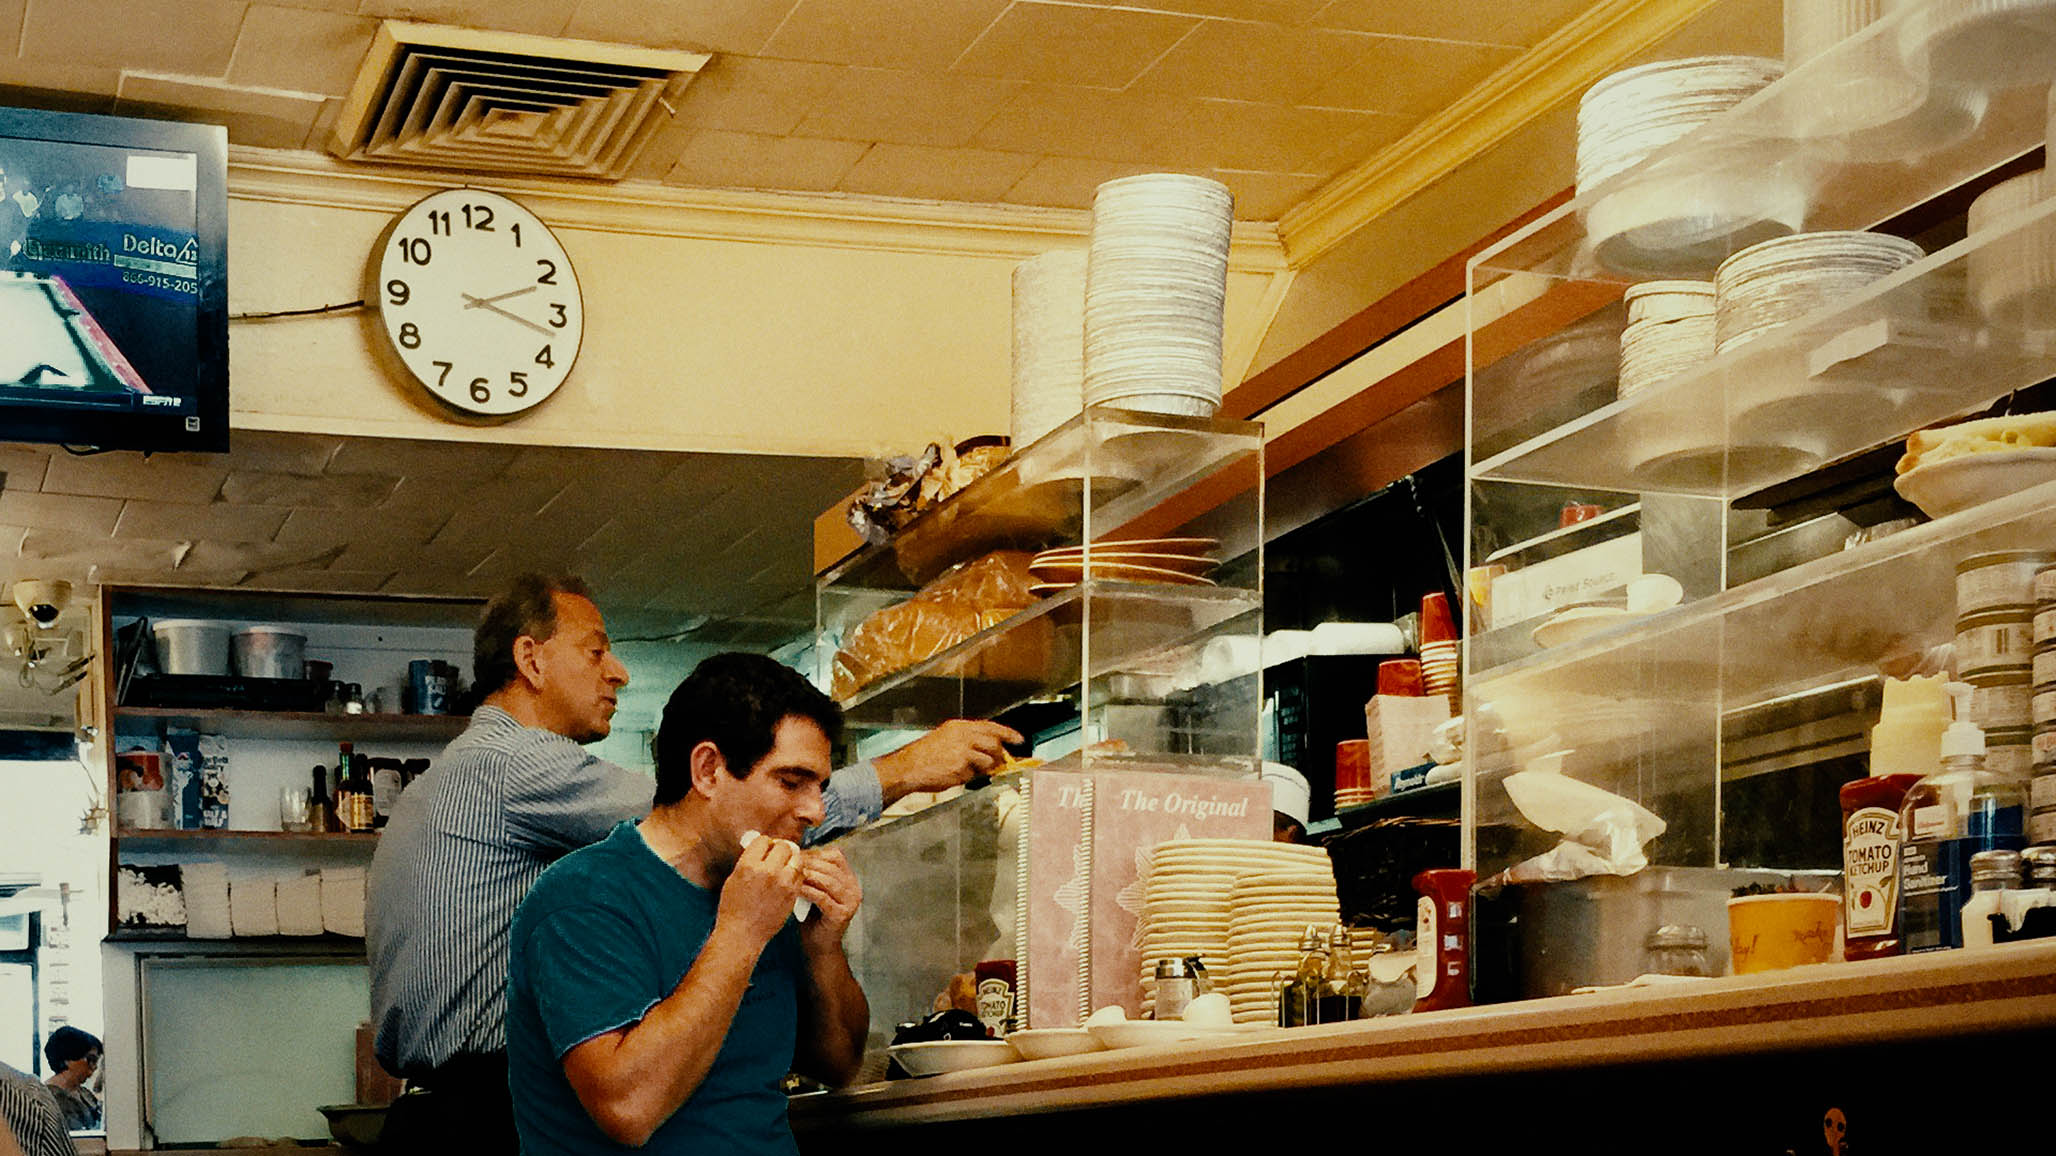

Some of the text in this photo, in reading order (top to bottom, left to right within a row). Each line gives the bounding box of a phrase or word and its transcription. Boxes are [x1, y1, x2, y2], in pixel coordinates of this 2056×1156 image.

[428, 210, 450, 236] 11
[461, 204, 495, 232] 12
[123, 233, 176, 258] Delta
[511, 223, 521, 248] 1
[398, 237, 432, 265] 10
[536, 259, 557, 285] 2
[387, 279, 410, 306] 9
[548, 303, 567, 328] 3
[399, 322, 421, 349] 8
[535, 344, 555, 369] 4
[432, 360, 453, 387] 7
[508, 371, 528, 397] 5
[469, 377, 490, 403] 6
[1058, 786, 1083, 808] Th
[1120, 789, 1249, 820] The Original
[1852, 820, 1886, 838] HEINZ
[1849, 844, 1892, 864] TOMATO
[1850, 860, 1890, 877] KETCHUP
